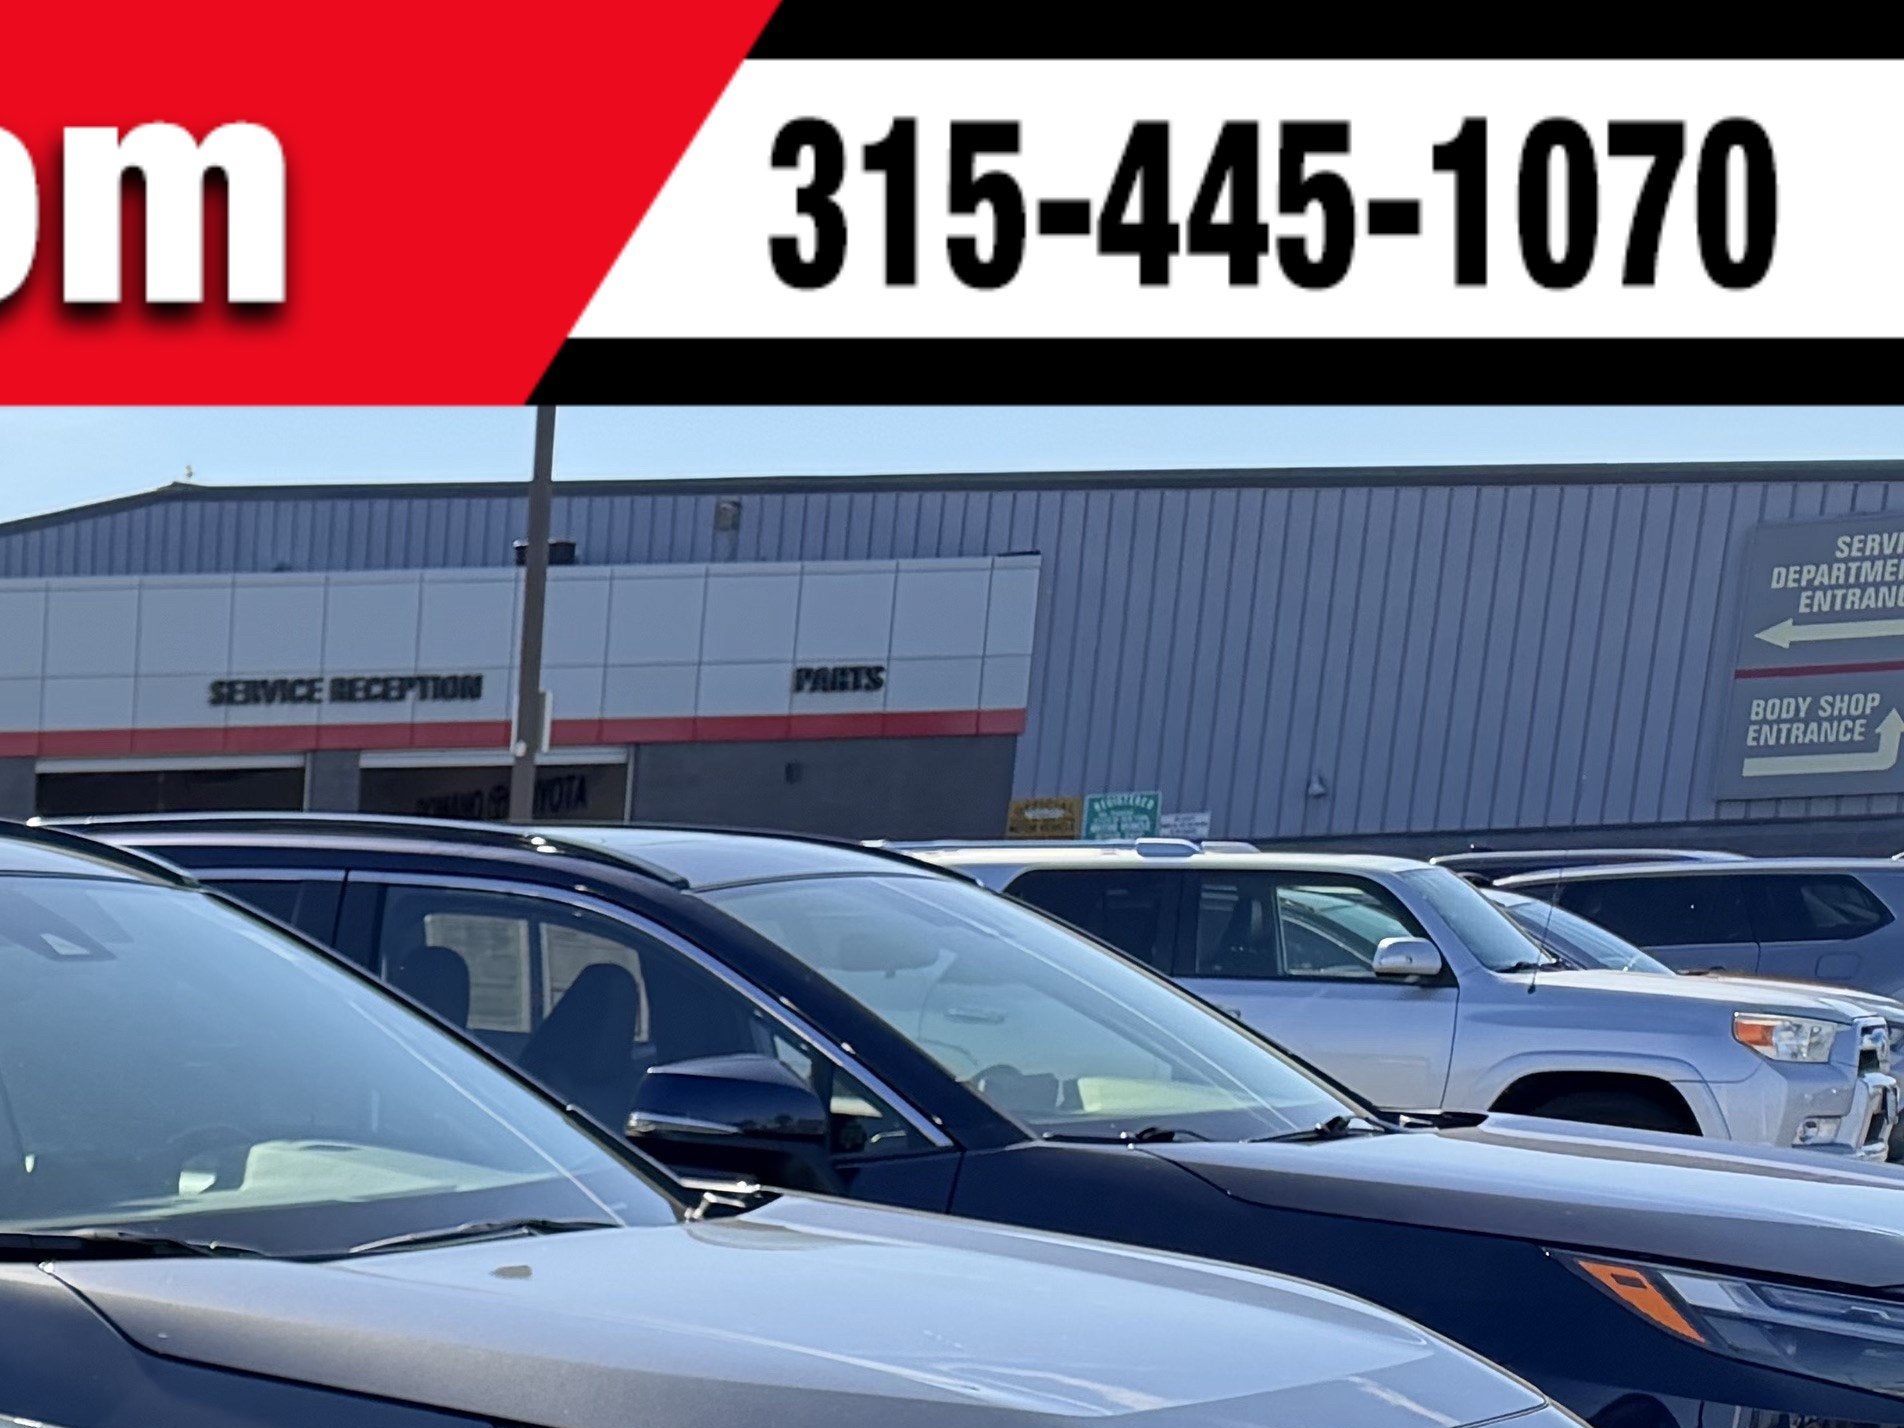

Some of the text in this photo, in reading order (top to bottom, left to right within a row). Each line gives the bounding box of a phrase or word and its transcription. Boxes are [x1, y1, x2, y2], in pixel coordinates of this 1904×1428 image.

[210, 674, 483, 705] SERVICE RECEPTION
[794, 666, 885, 693] PARTS
[1750, 693, 1880, 721] BODY SHOP
[1746, 719, 1867, 746] ENTRANCE
